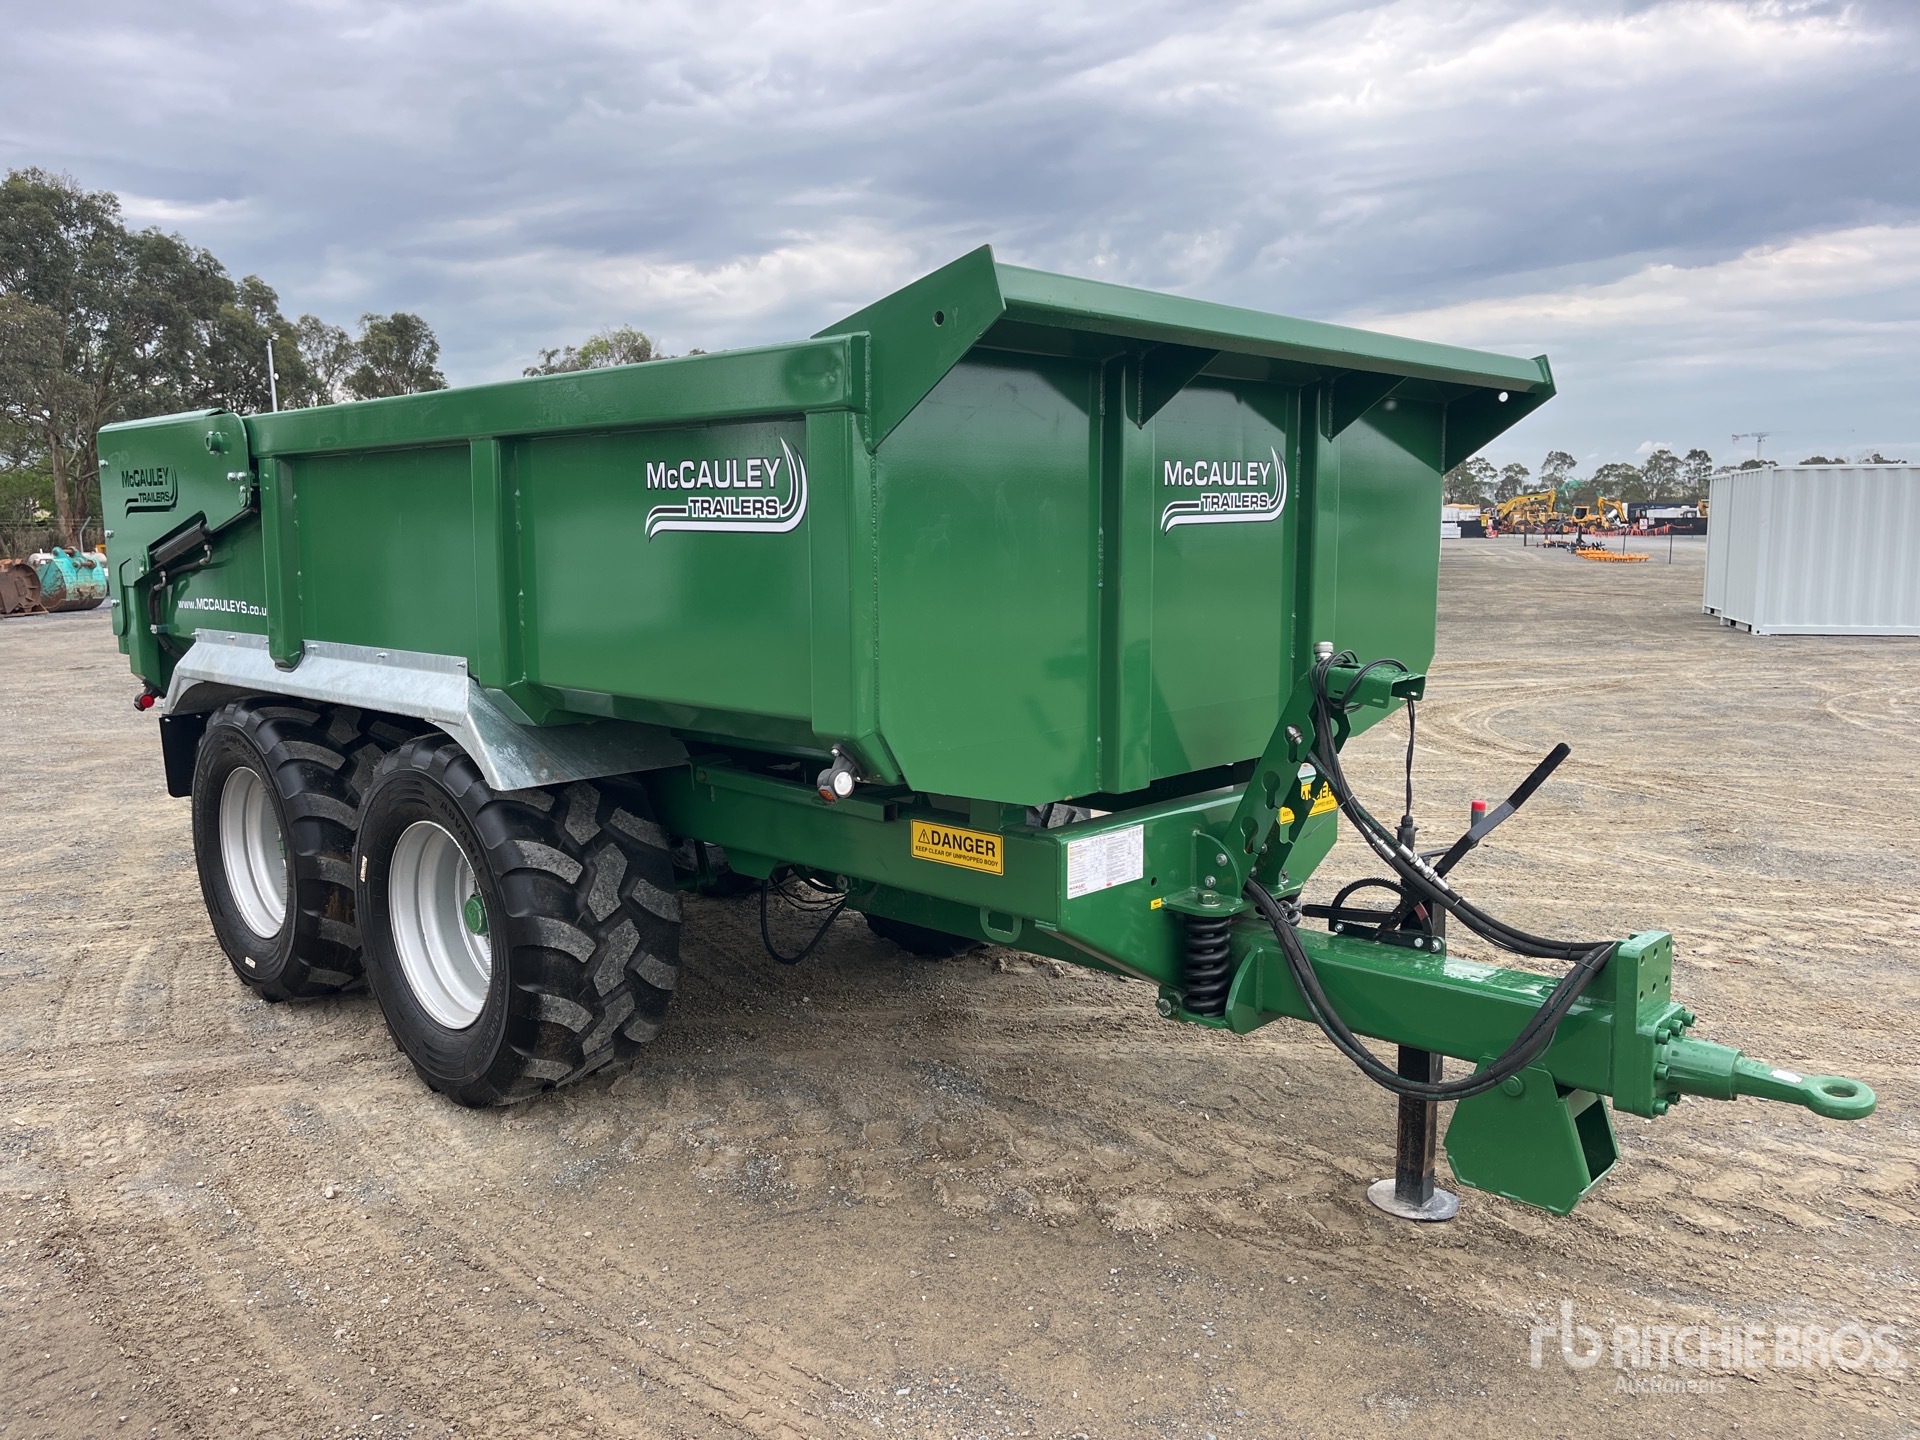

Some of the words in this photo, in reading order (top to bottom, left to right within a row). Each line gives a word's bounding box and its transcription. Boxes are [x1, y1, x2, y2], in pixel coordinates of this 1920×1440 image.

[121, 466, 169, 488] McCAULEY
[646, 456, 782, 490] McCAULEY
[1164, 460, 1272, 487] McCAULEY
[138, 491, 170, 503] TRAILERS
[688, 496, 780, 519] TRAILERS
[1201, 492, 1270, 512] TRAILERS
[177, 597, 267, 616] www.MCCAULEYS.co.u
[931, 830, 996, 858] DANGER
[928, 847, 945, 856] CLEAR
[952, 853, 984, 864] UNPROPPED
[983, 859, 999, 867] BODY
